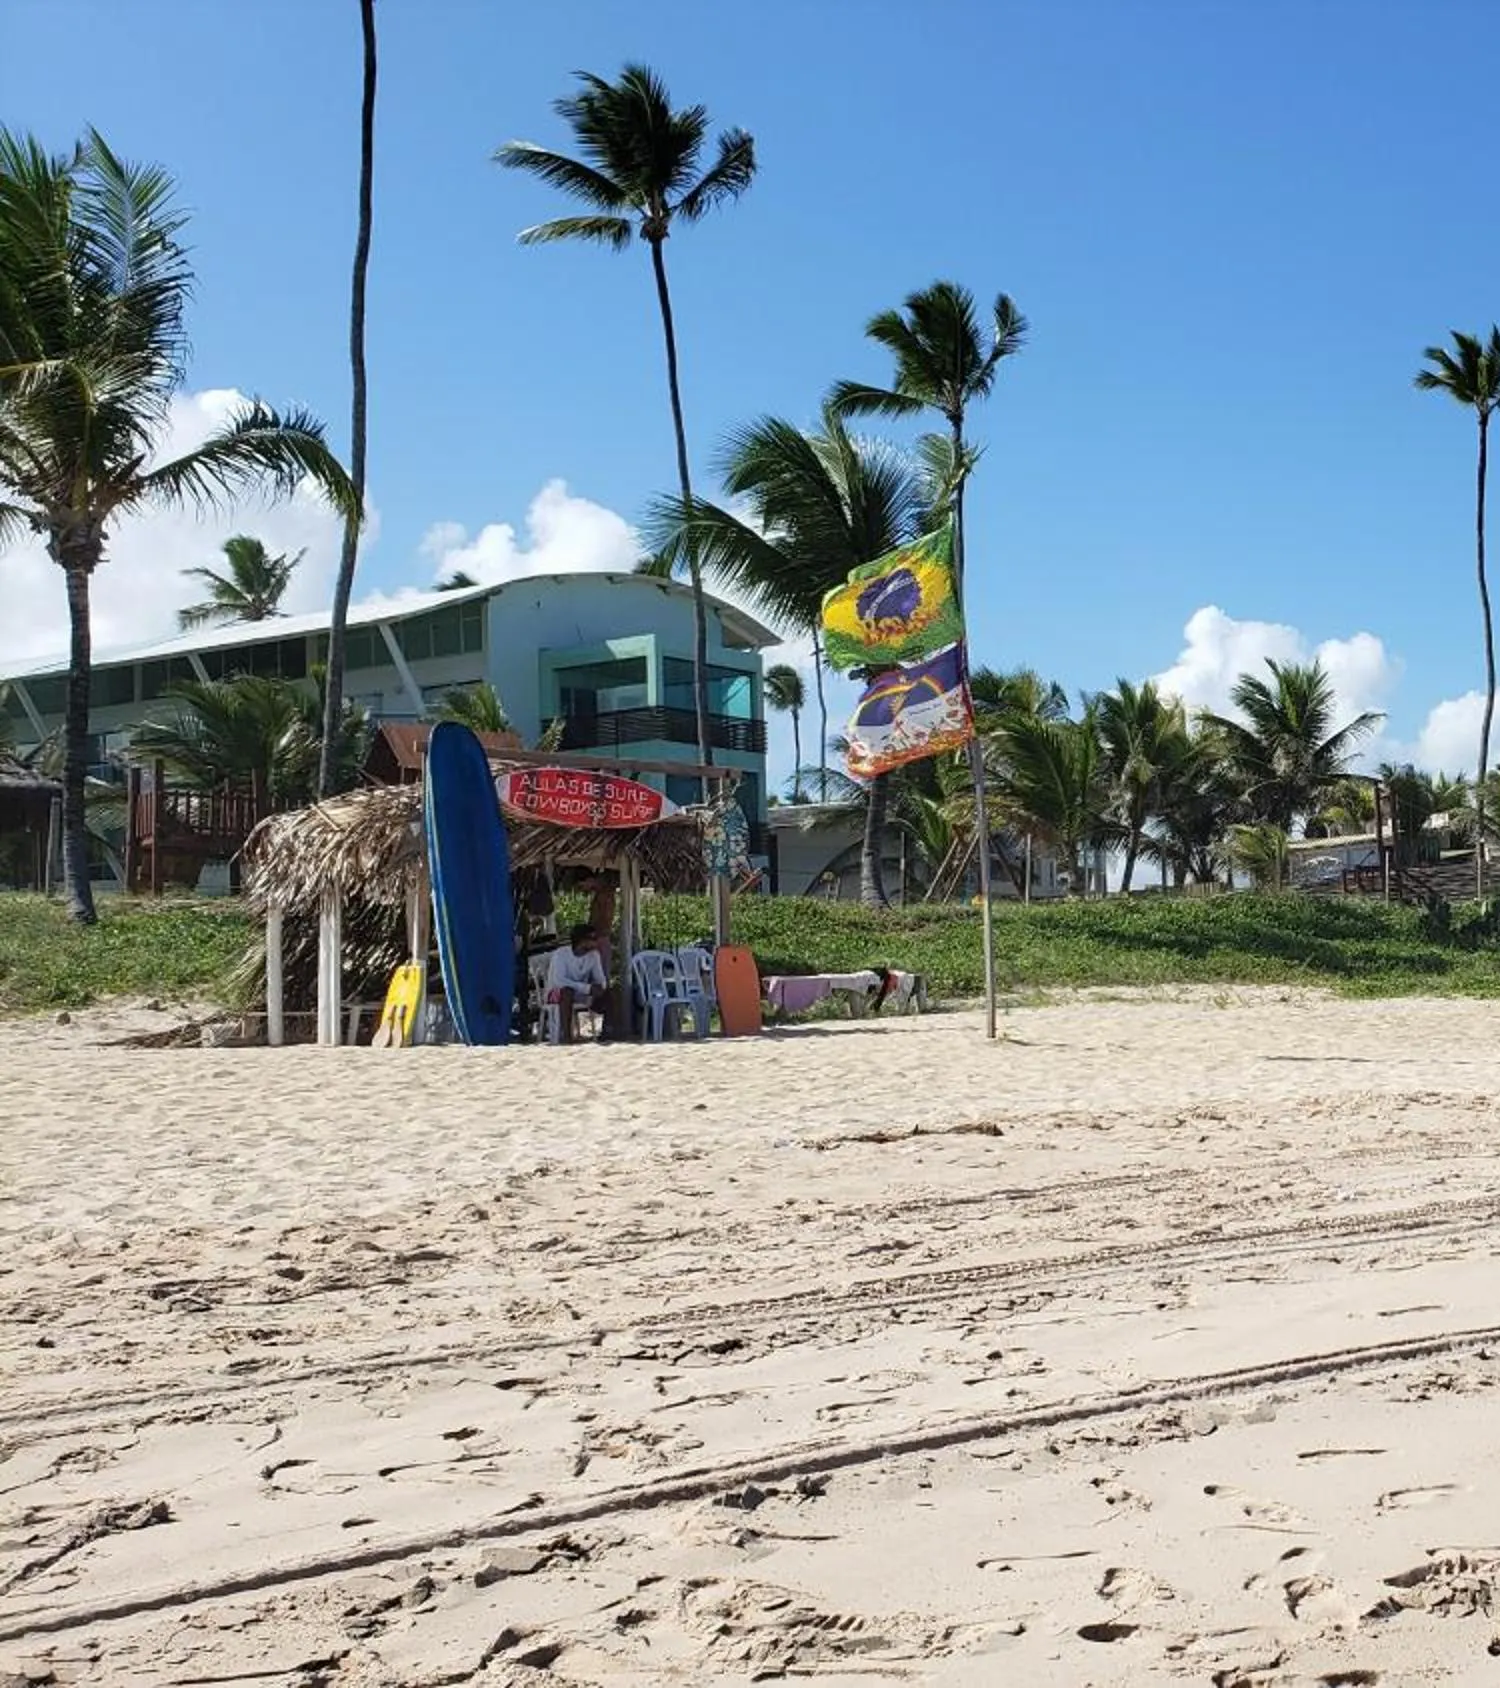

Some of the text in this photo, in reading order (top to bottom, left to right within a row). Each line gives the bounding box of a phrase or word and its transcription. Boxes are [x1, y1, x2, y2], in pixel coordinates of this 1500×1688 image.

[519, 774, 649, 802] AULAS DE SURF
[610, 803, 656, 820] SURF
